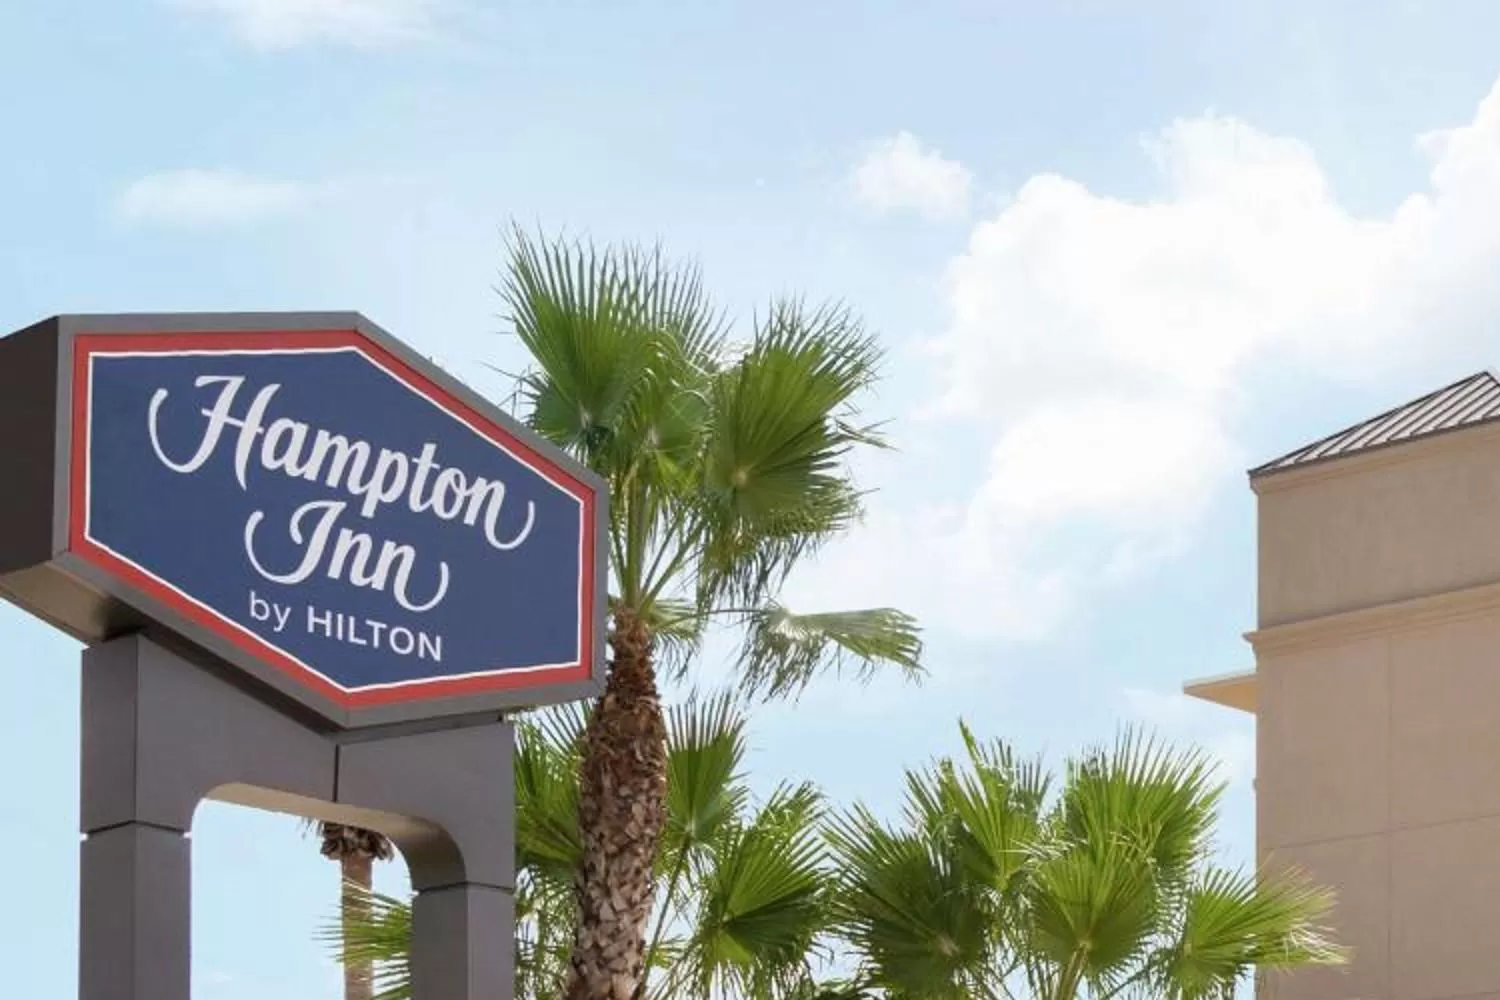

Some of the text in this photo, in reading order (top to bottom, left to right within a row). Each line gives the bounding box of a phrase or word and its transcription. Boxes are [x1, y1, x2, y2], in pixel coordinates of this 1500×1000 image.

[148, 375, 535, 549] Hampton
[245, 501, 449, 611] Inn
[249, 591, 442, 661] by HILTON
